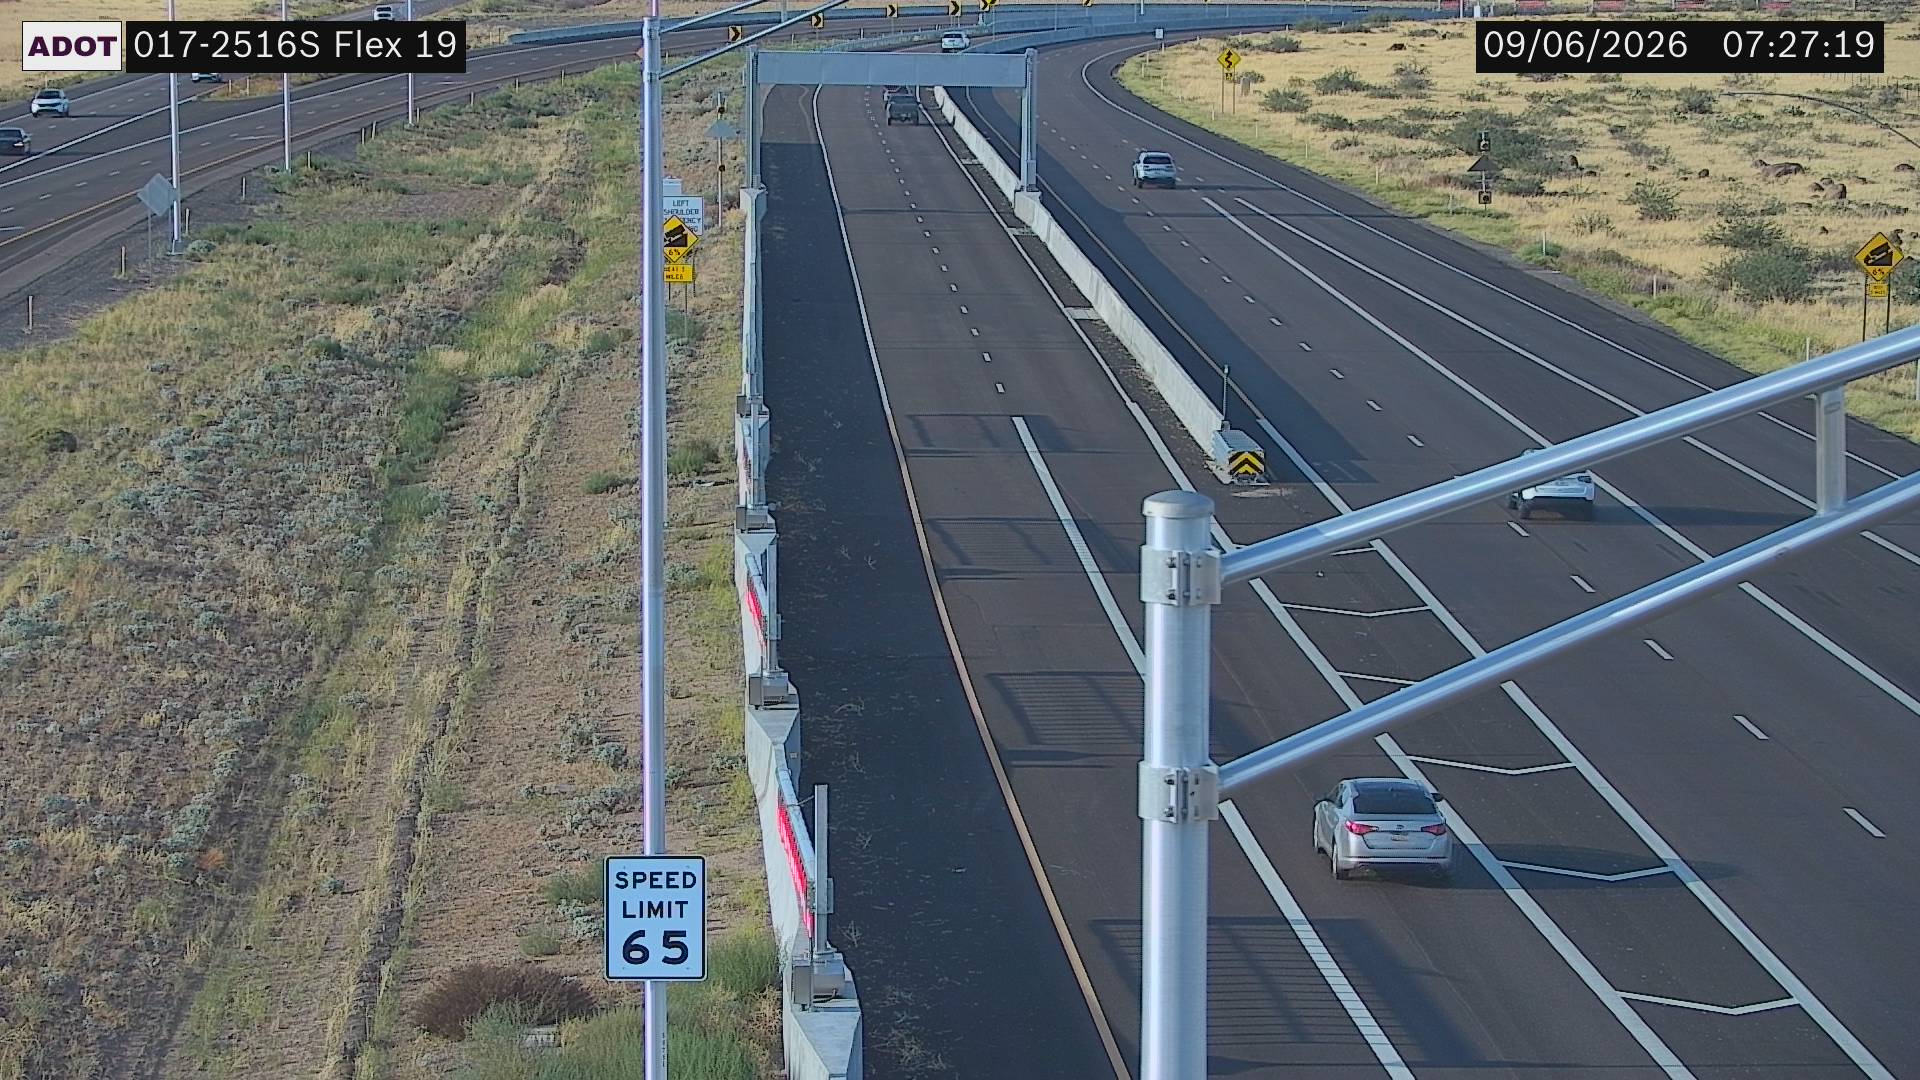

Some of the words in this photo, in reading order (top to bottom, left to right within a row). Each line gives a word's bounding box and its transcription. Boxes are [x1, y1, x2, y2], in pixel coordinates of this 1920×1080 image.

[668, 248, 681, 256] 6%
[614, 871, 697, 889] SPEED
[622, 900, 689, 918] LIMIT
[622, 929, 689, 965] 65
